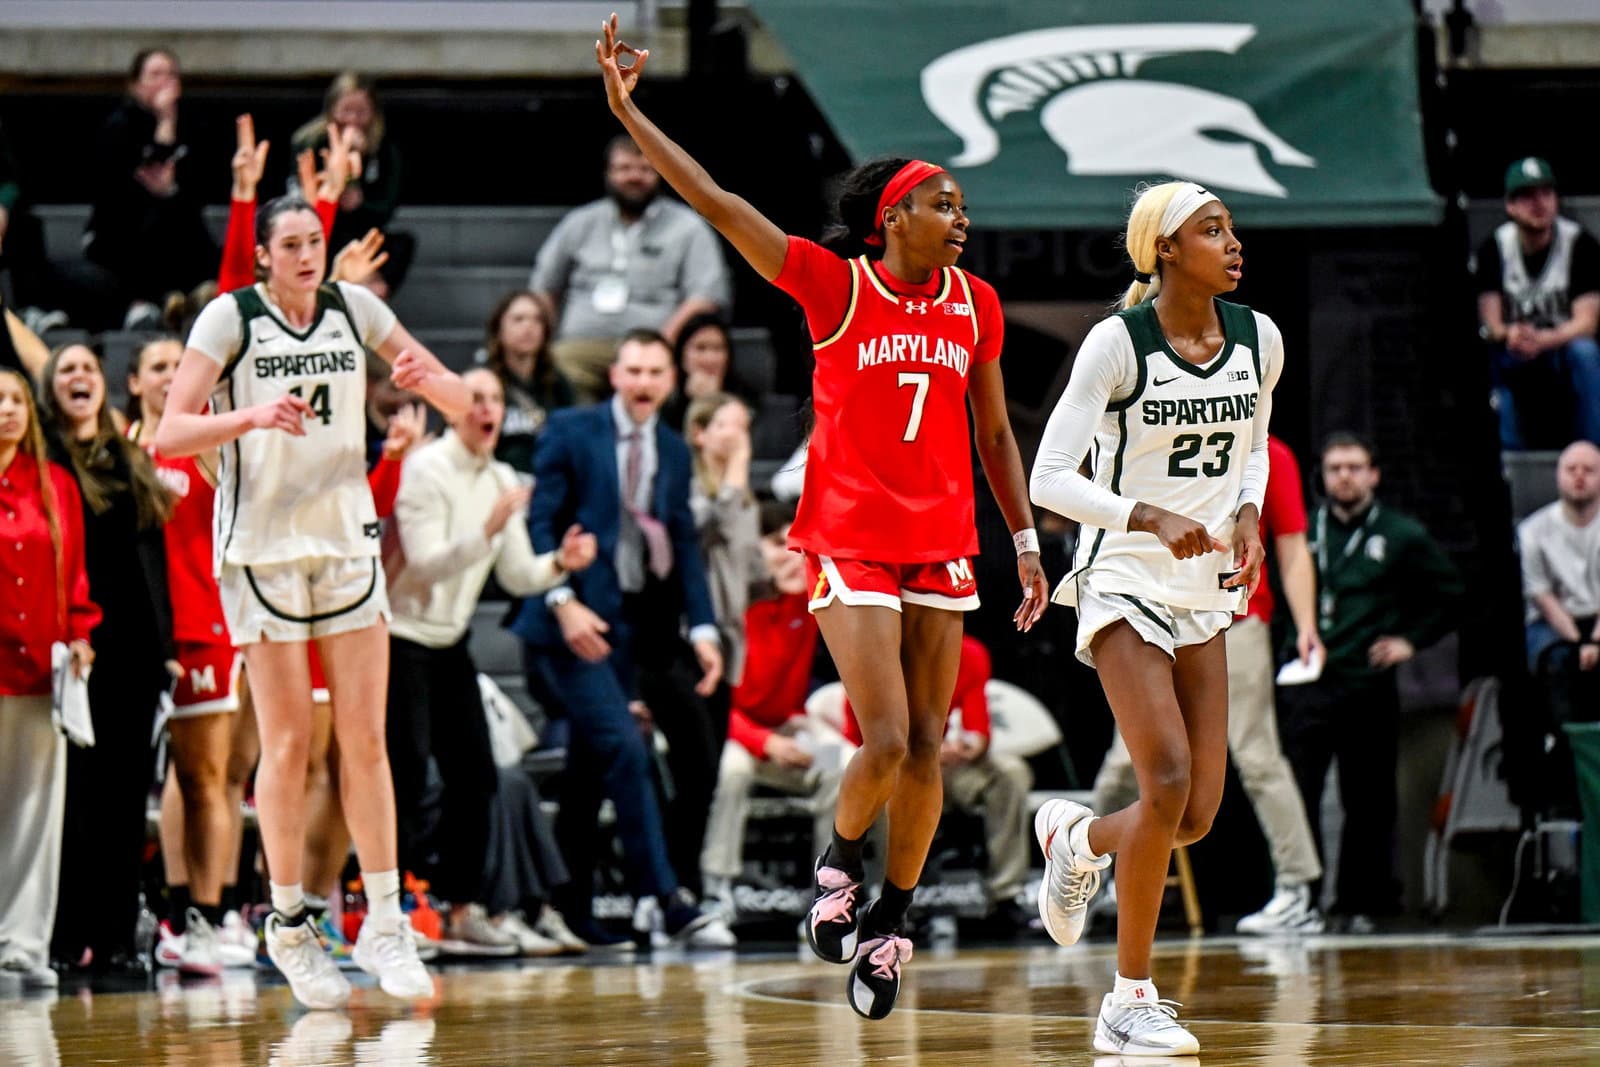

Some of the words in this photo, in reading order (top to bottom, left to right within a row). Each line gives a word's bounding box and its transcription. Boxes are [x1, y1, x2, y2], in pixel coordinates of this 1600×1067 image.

[255, 350, 356, 378] SPARTANS
[857, 334, 970, 379] MARYLAND
[897, 371, 930, 442] 7
[1142, 392, 1258, 426] SPARTANS
[1168, 431, 1236, 478] 23
[944, 556, 974, 589] M
[190, 664, 218, 694] M
